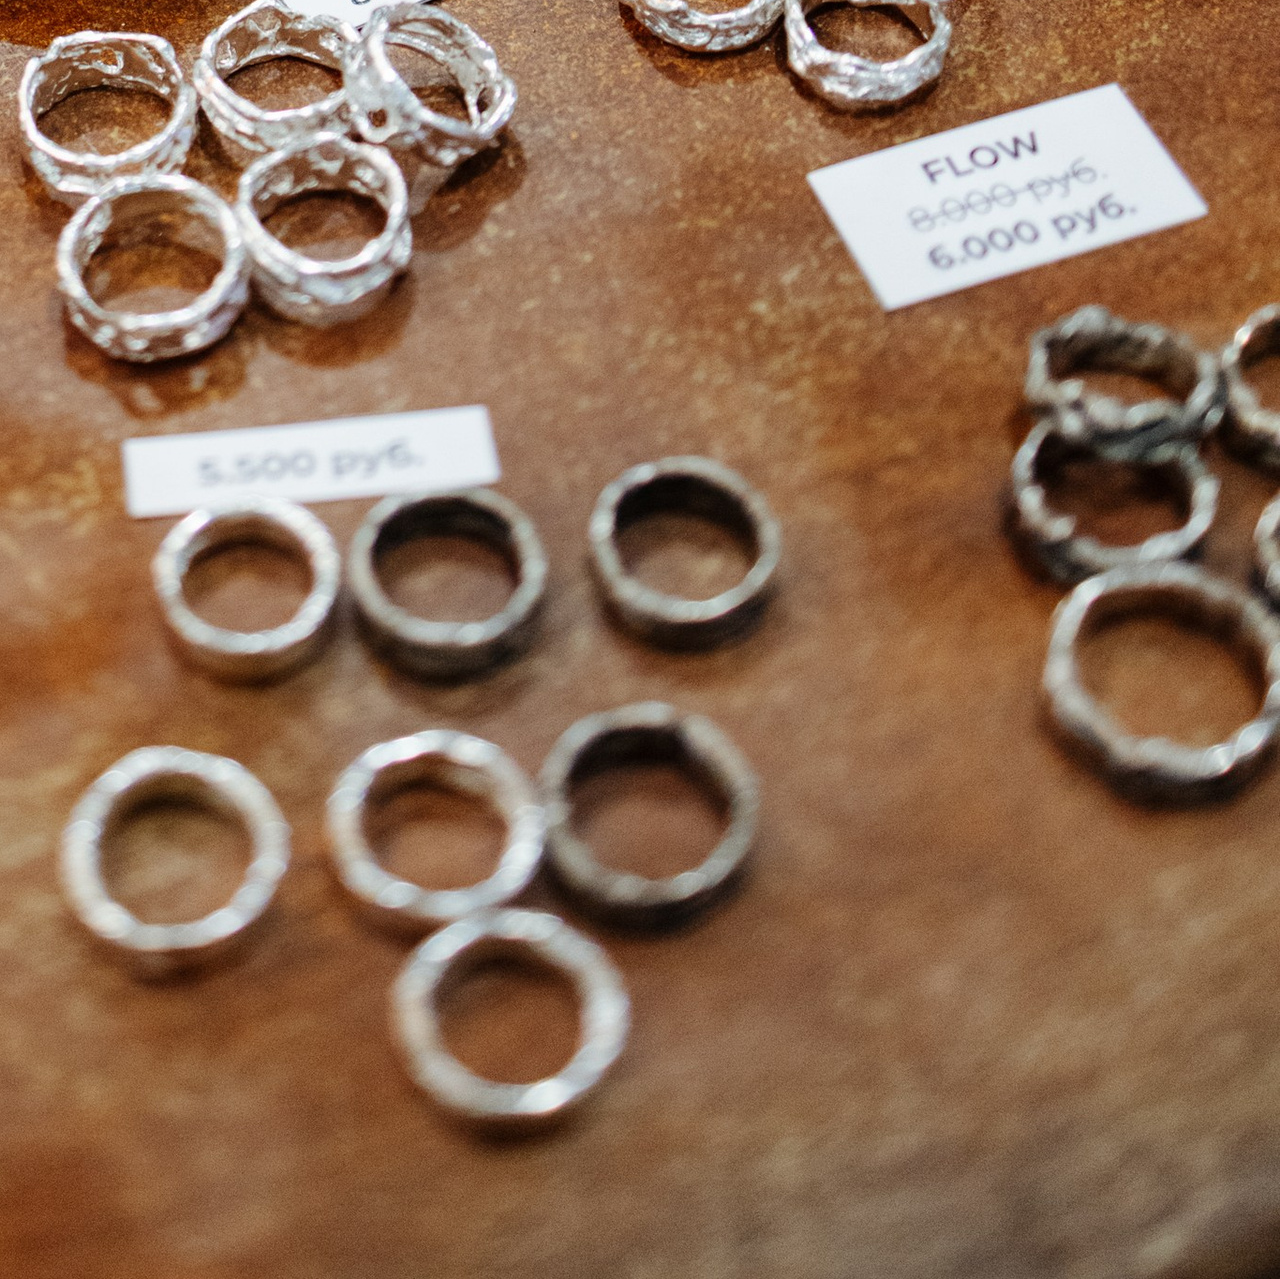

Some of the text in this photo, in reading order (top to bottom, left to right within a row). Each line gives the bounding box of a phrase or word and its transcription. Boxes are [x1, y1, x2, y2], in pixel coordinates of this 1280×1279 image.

[920, 131, 1041, 185] FLOW
[1027, 156, 1109, 204] руб.
[927, 192, 1138, 271] 6.000 руб.
